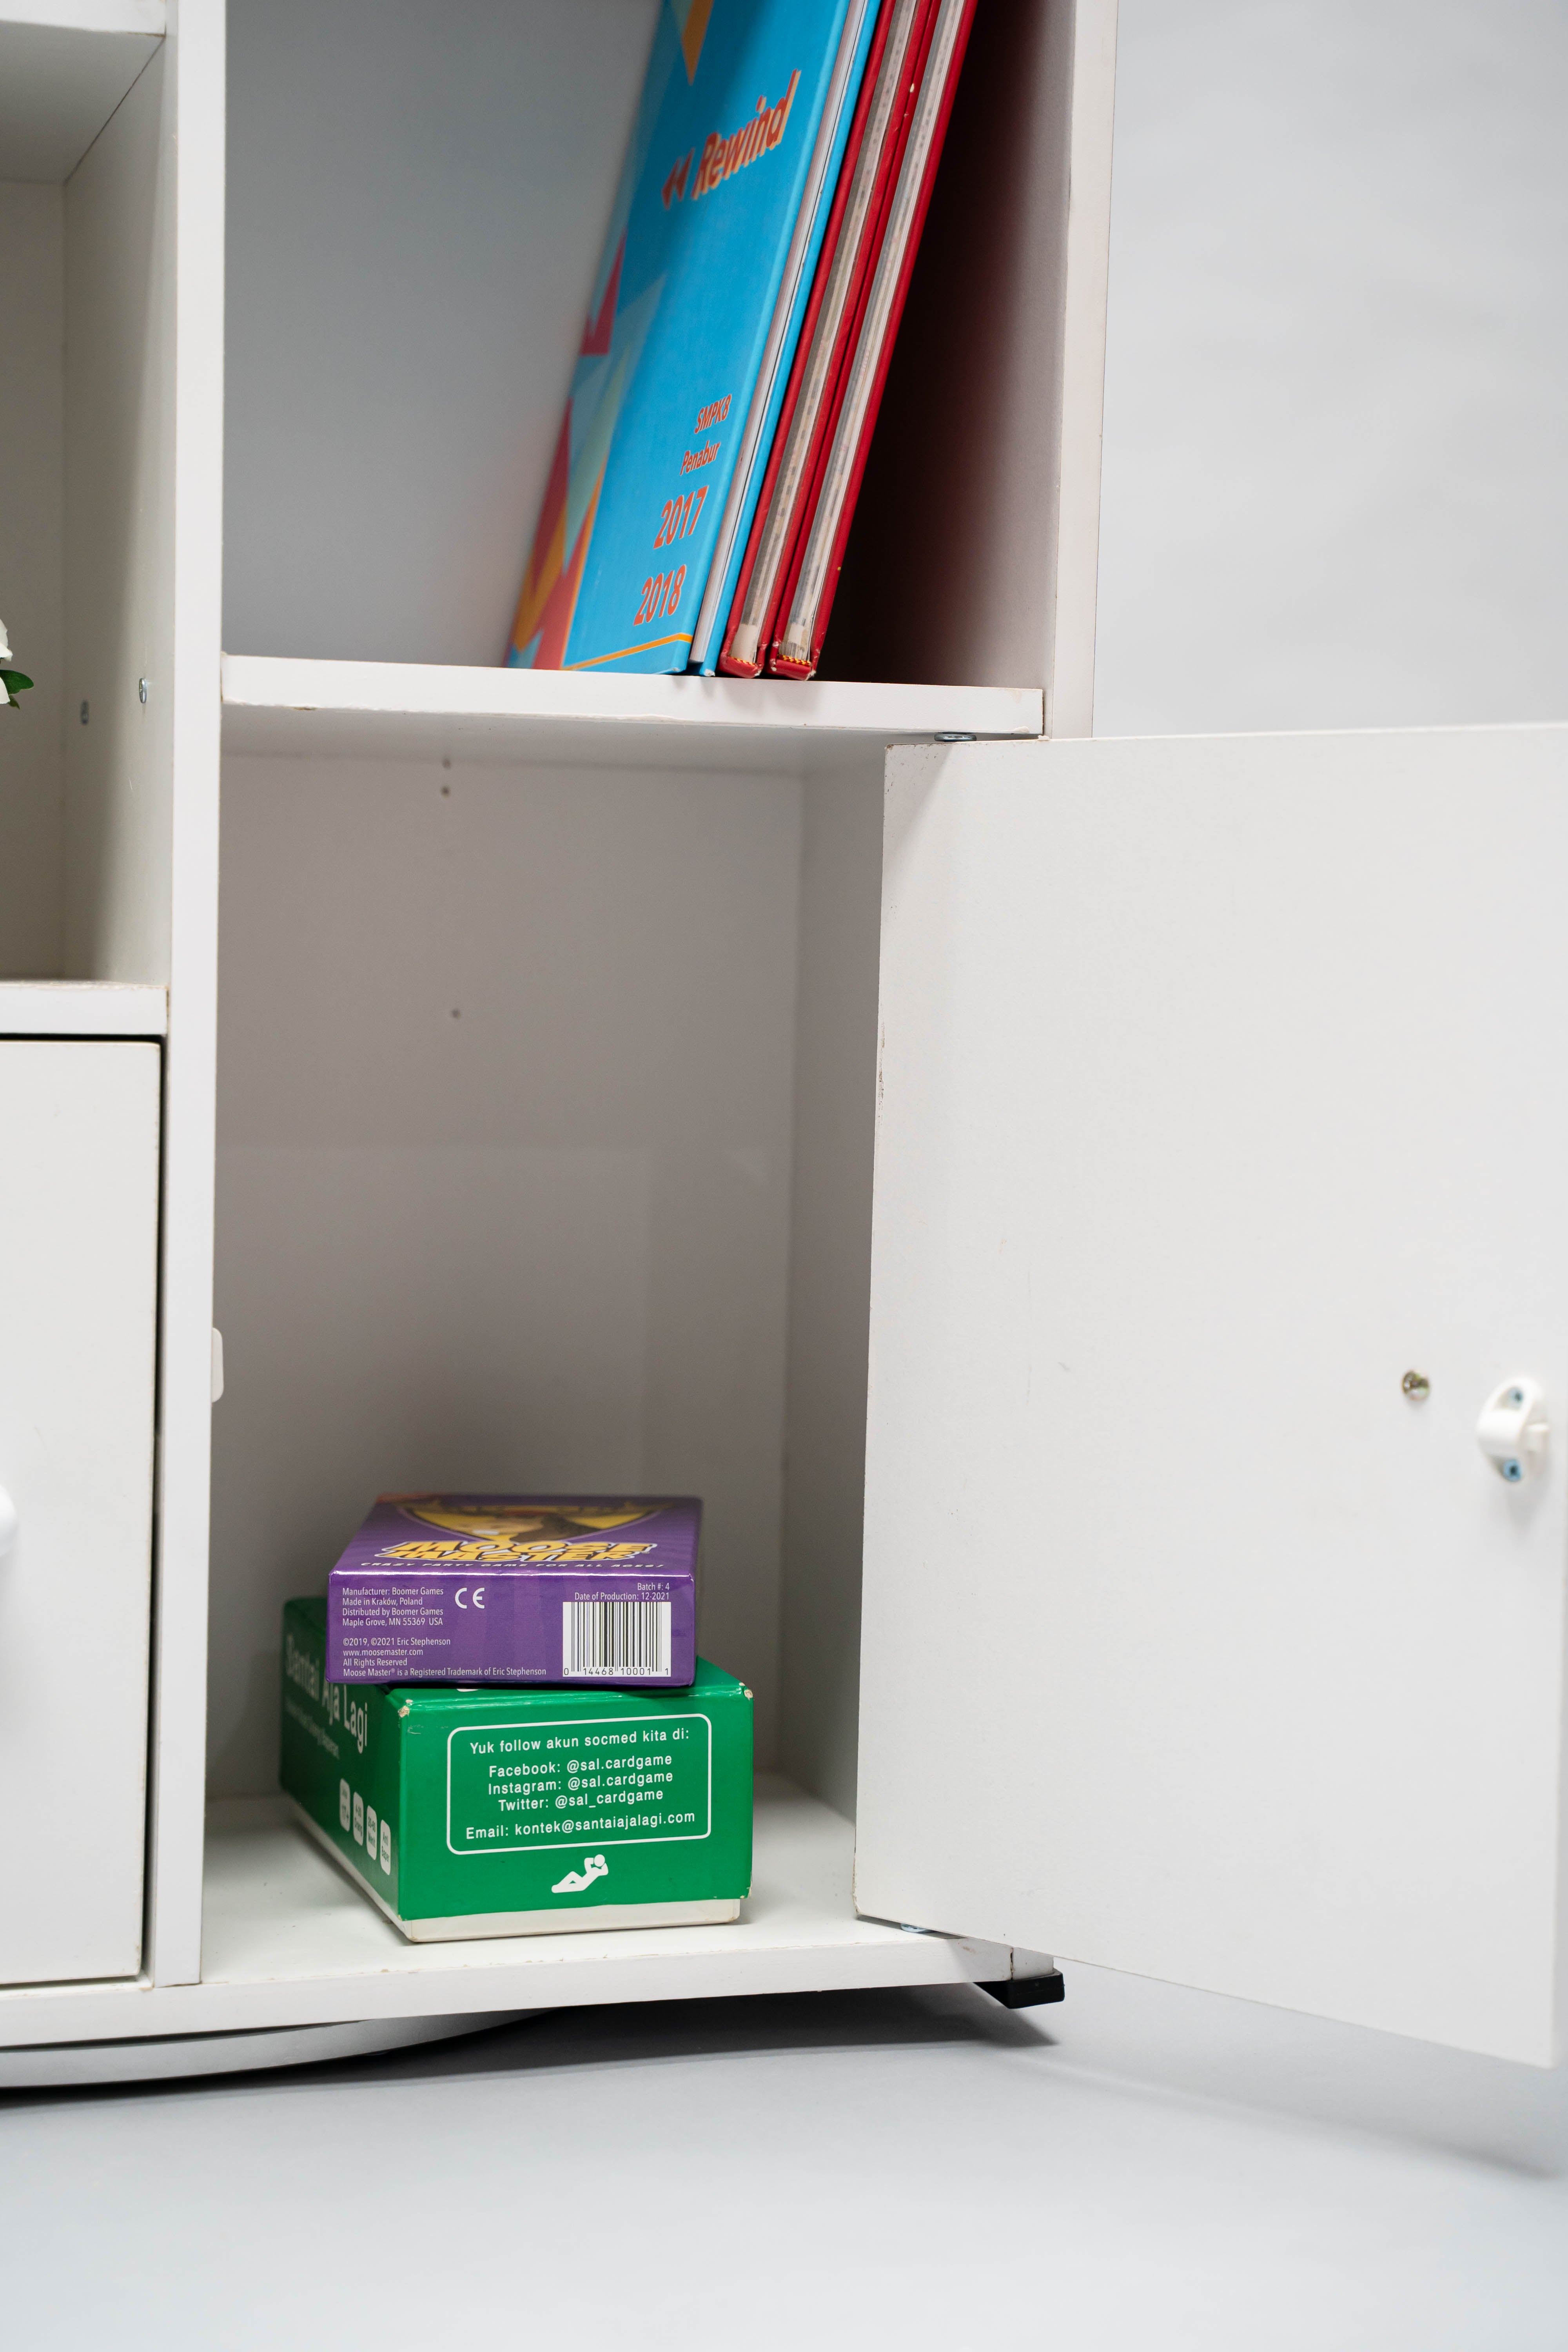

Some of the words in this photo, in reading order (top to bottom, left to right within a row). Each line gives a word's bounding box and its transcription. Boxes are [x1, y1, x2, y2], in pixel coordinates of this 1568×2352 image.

[691, 69, 801, 200] Rewind
[694, 394, 732, 434] SMPK8
[680, 440, 720, 476] Penabur
[653, 485, 709, 550] 2017
[633, 564, 687, 626] 2018
[375, 1551, 634, 1562] MASTER
[382, 1541, 657, 1552] MOOSE
[343, 1587, 390, 1595] Manufacturer:
[392, 1587, 419, 1595] Boomer
[420, 1587, 444, 1595] Games
[343, 1597, 362, 1606] Made
[372, 1597, 398, 1606] Kraków,
[399, 1597, 423, 1605] Poland
[343, 1607, 380, 1616] Distributed
[382, 1607, 390, 1618] by
[392, 1607, 419, 1615] Boomer
[420, 1607, 443, 1615] Games
[343, 1617, 364, 1628] Maple
[365, 1618, 387, 1627] Grove,
[389, 1617, 401, 1626] MN
[403, 1617, 425, 1626] 55369
[429, 1617, 443, 1626] USA
[343, 1638, 369, 1647] ©2019,
[371, 1637, 394, 1646] ©2021
[397, 1637, 409, 1646] Eric
[410, 1637, 451, 1647] Stephenson
[343, 1658, 352, 1666] All
[354, 1658, 375, 1668] Rights
[377, 1657, 407, 1666] Reserved
[410, 1668, 446, 1677] Registered
[447, 1668, 483, 1676] Trademark
[484, 1667, 491, 1676] of
[493, 1667, 505, 1675] Eric
[506, 1667, 546, 1677] Stephenson
[343, 1684, 368, 1755] Lagi
[470, 1742, 494, 1755] Yuk
[500, 1739, 541, 1752] follow
[546, 1738, 579, 1749] akun
[584, 1731, 637, 1746] socmed
[643, 1729, 667, 1742] kita
[673, 1728, 689, 1740] di:
[489, 1762, 560, 1777] Facebook:
[567, 1755, 672, 1773] @sal.cardgame
[488, 1780, 562, 1795] Instagram:
[568, 1771, 673, 1791] @sal.cardgame
[499, 1798, 548, 1812] Twitter:
[555, 1789, 663, 1809] @sal_cardgame
[466, 1825, 508, 1840] Email:
[515, 1812, 695, 1836] kontek@santaiajalagi.com
